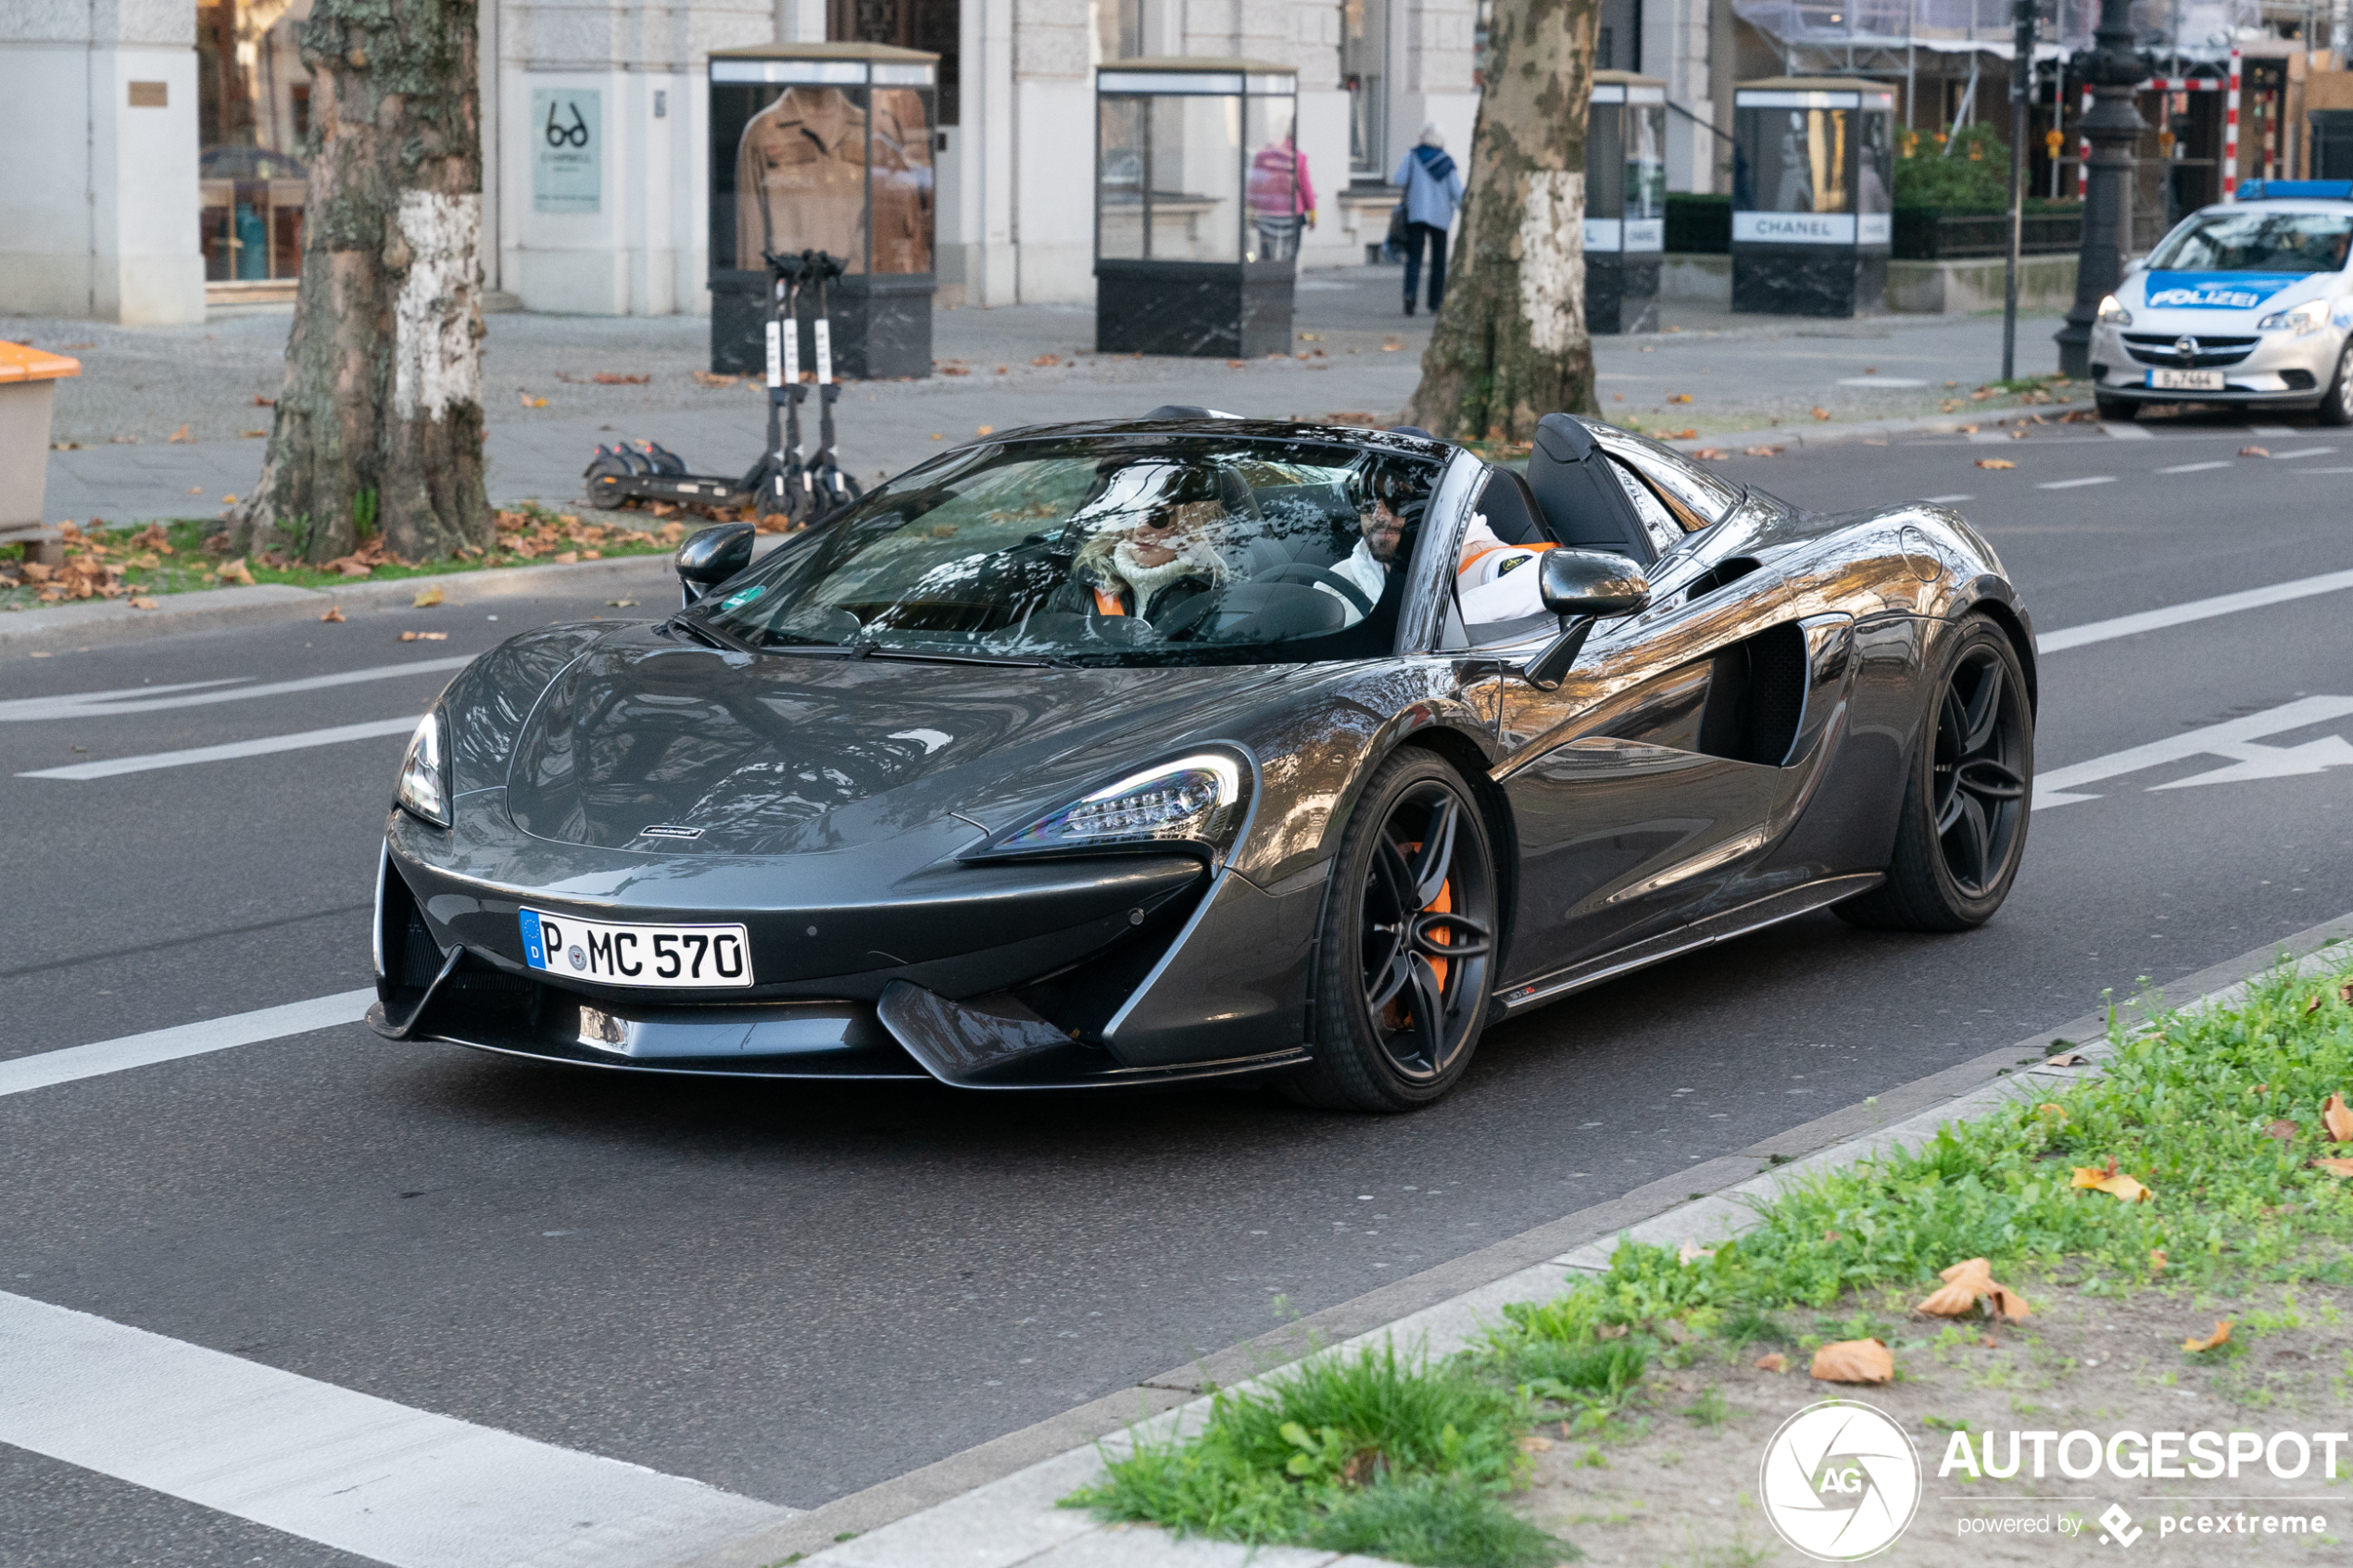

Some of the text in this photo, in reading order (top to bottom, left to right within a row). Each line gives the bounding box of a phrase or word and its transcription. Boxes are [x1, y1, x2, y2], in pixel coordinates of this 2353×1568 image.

[1755, 219, 1831, 236] CHANEL
[2149, 288, 2259, 307] POLIZEI
[531, 946, 539, 959] D
[540, 921, 743, 979] P MC 570
